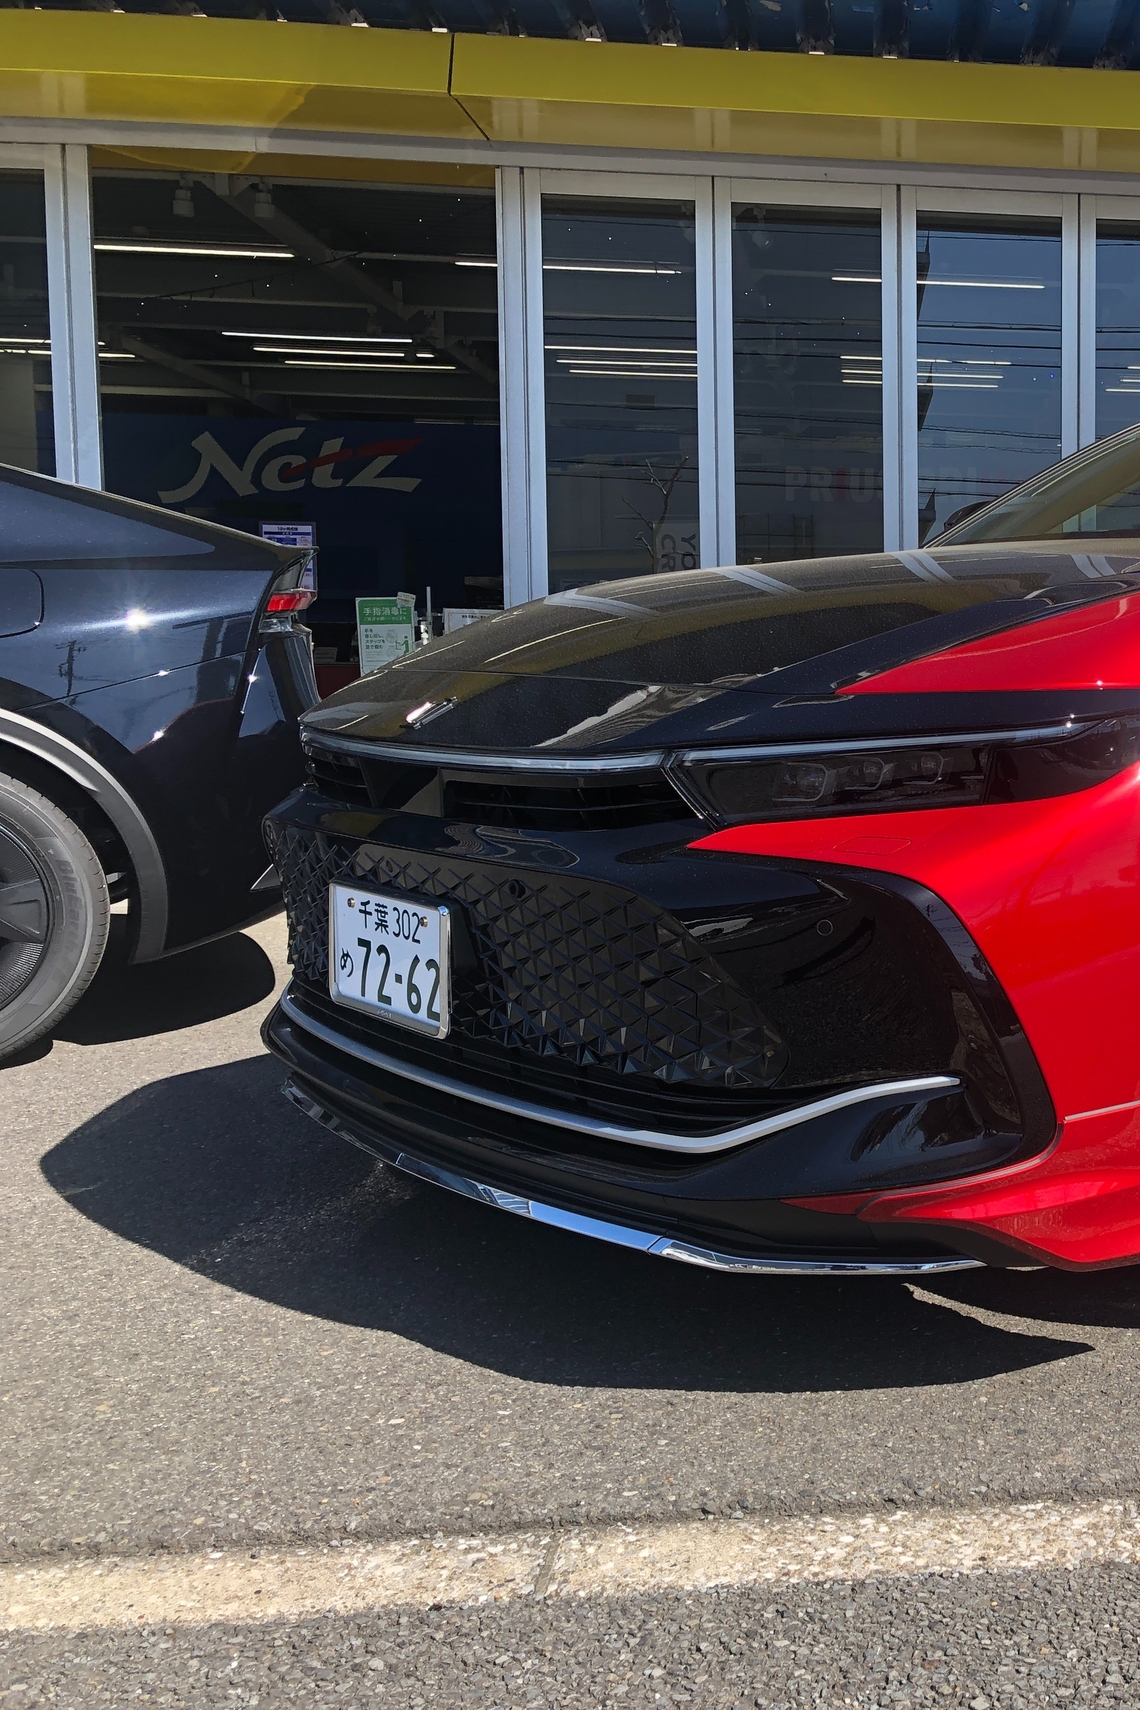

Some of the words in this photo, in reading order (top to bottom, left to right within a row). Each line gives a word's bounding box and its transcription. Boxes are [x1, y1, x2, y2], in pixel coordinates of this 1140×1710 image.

[157, 427, 425, 504] Netz
[363, 606, 407, 616] 手指消毒に
[359, 900, 389, 935] 千葉
[393, 906, 421, 944] 302
[340, 947, 354, 978] め
[357, 937, 441, 1023] 72-62
